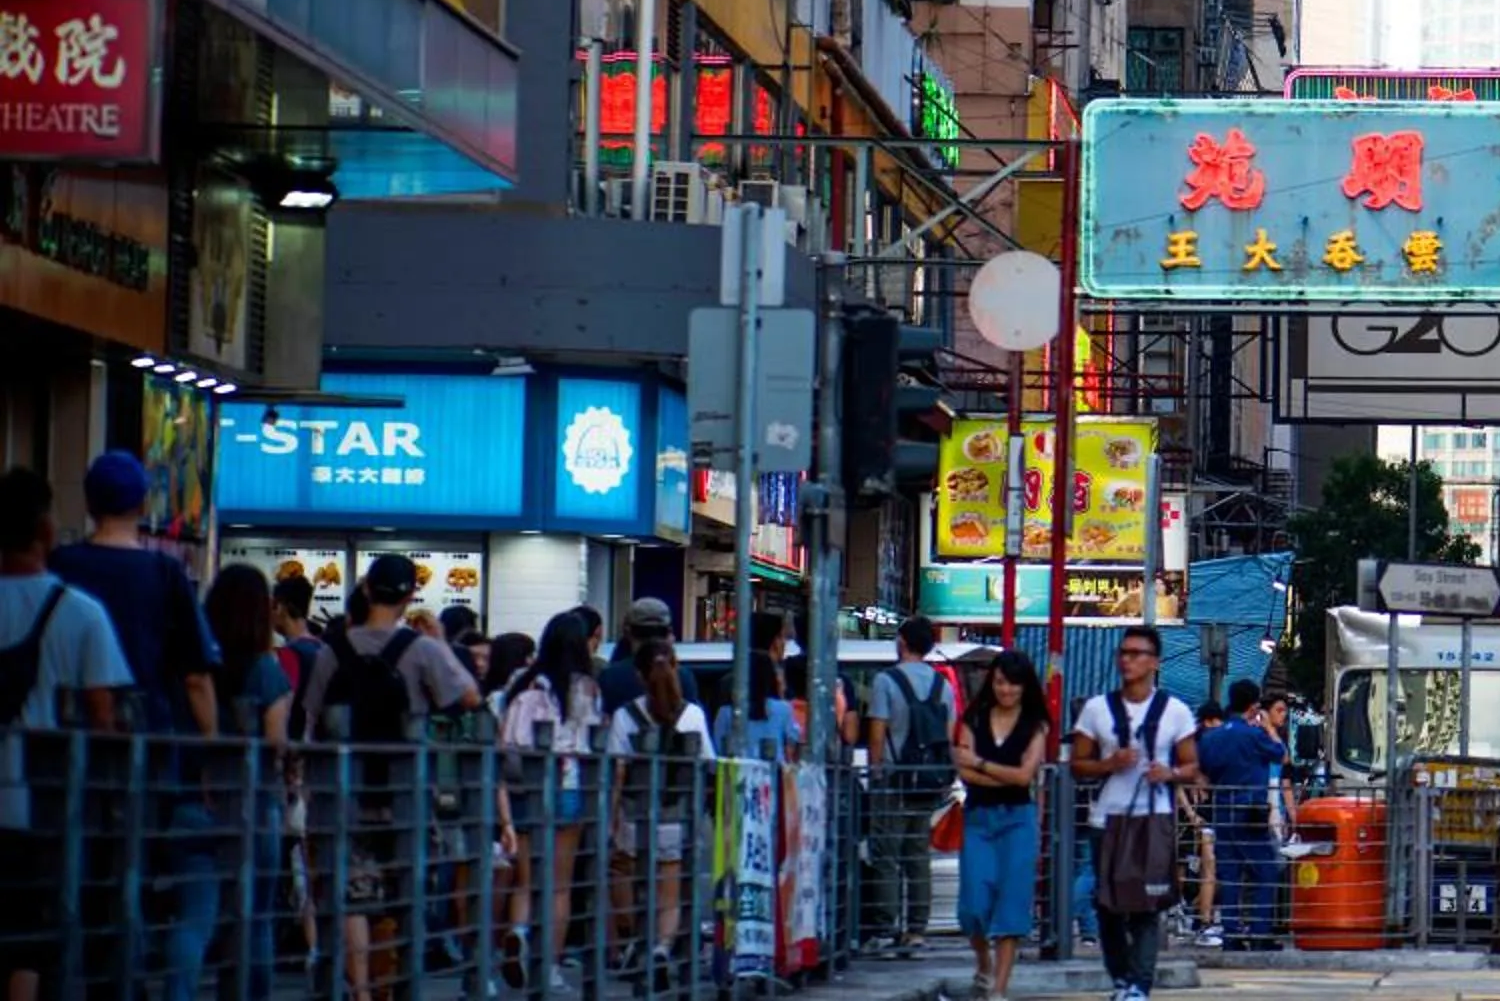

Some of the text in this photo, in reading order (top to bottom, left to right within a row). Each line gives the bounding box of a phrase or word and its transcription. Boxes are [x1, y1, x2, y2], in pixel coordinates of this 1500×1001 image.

[0, 102, 121, 135] HEATRE
[1178, 127, 1428, 211] 明苑
[1160, 229, 1444, 271] 雲吞大王
[219, 418, 426, 456] -STAR
